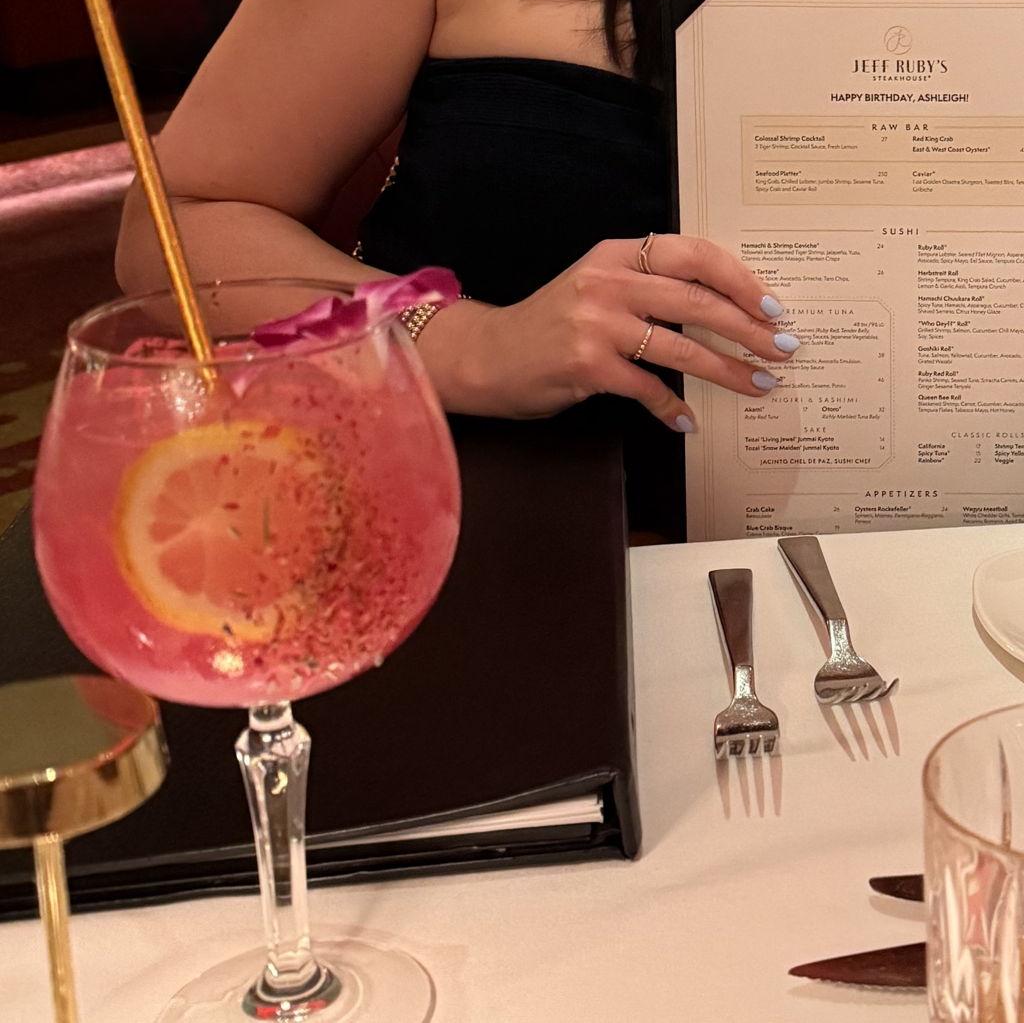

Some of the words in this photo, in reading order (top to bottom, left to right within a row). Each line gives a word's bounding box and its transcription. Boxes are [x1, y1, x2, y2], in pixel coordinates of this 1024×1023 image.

[852, 59, 890, 73] JEFF
[896, 59, 948, 73] RUBY'S
[831, 93, 863, 102] HAPPY
[864, 93, 916, 103] BIRTHDAY,
[917, 93, 969, 102] ASHLEIGH!
